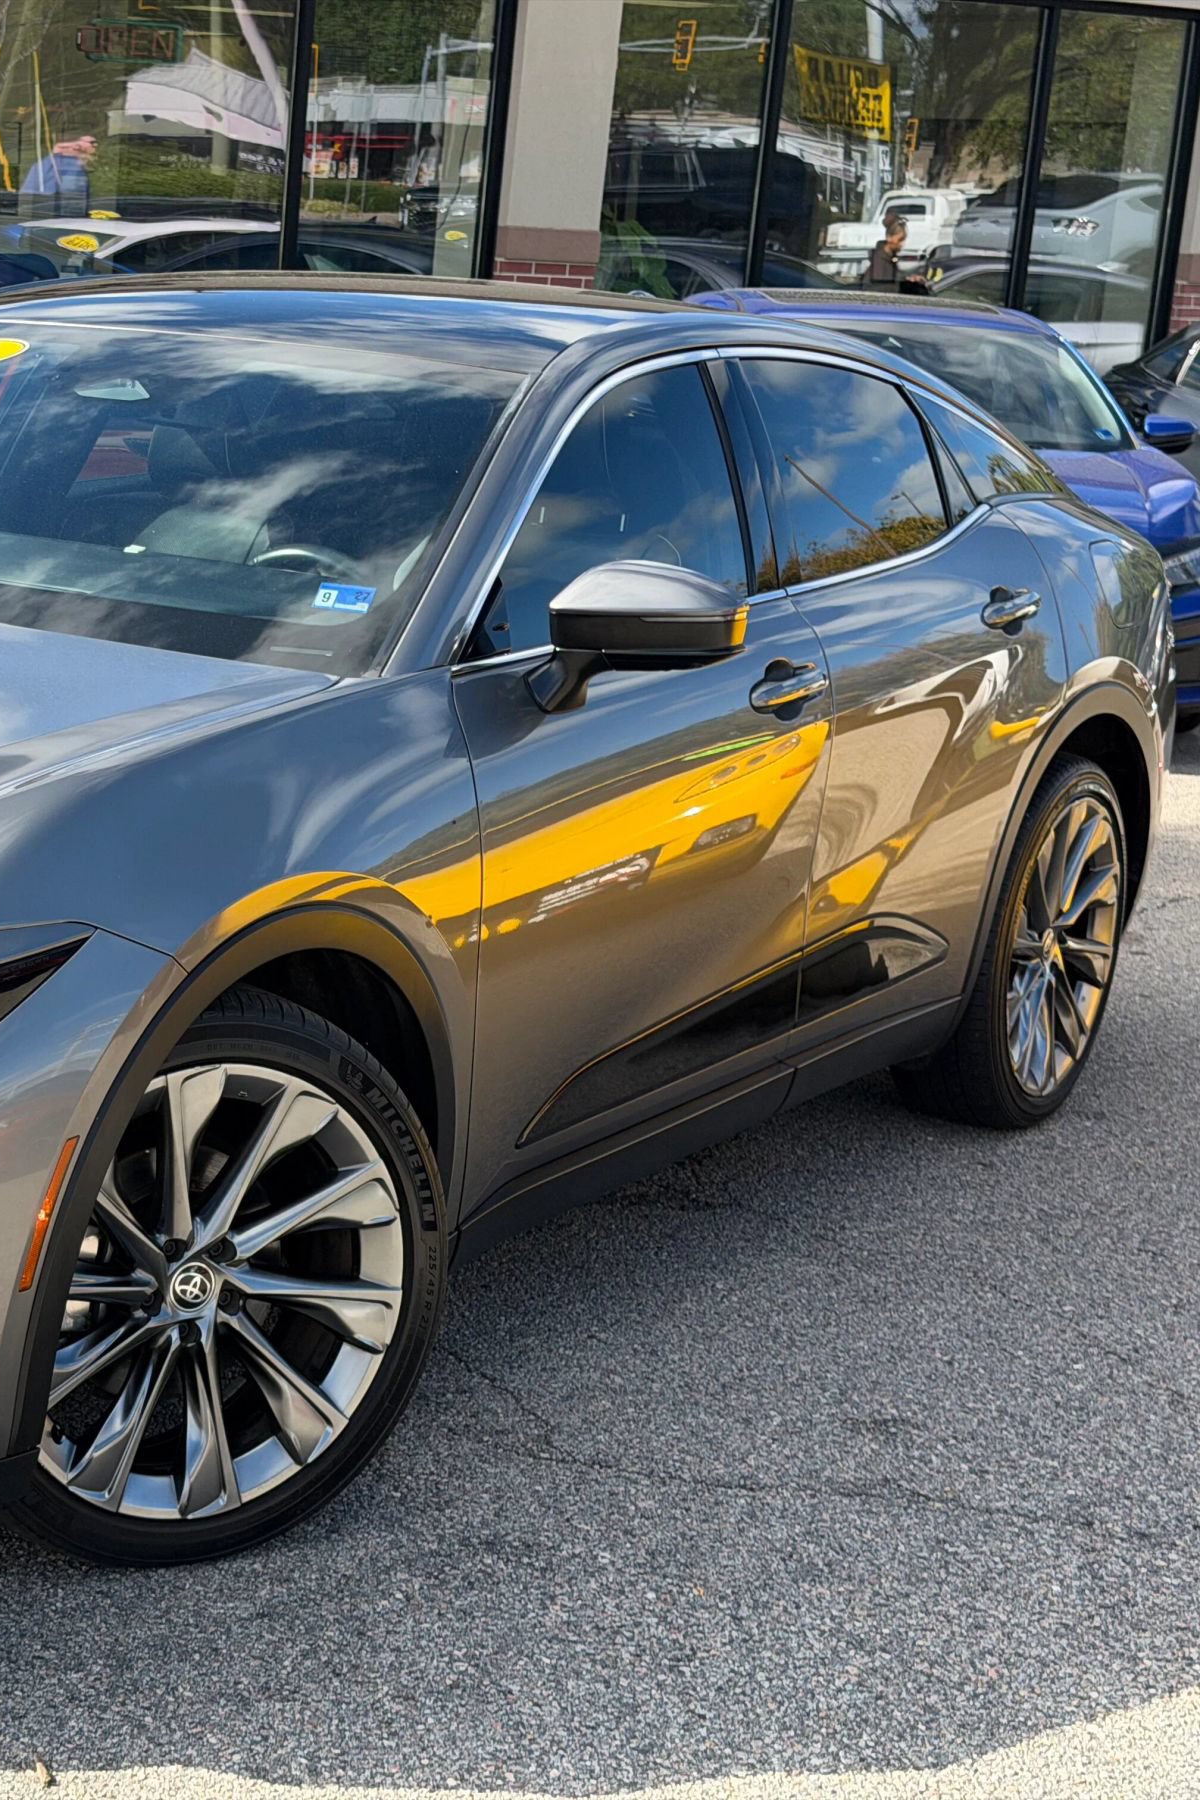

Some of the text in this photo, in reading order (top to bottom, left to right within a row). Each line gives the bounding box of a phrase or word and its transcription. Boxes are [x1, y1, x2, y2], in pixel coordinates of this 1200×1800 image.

[77, 26, 176, 60] OPEN
[321, 591, 372, 602] 9 27
[365, 1086, 436, 1223] MICHELIN
[424, 1245, 438, 1298] 225/45
